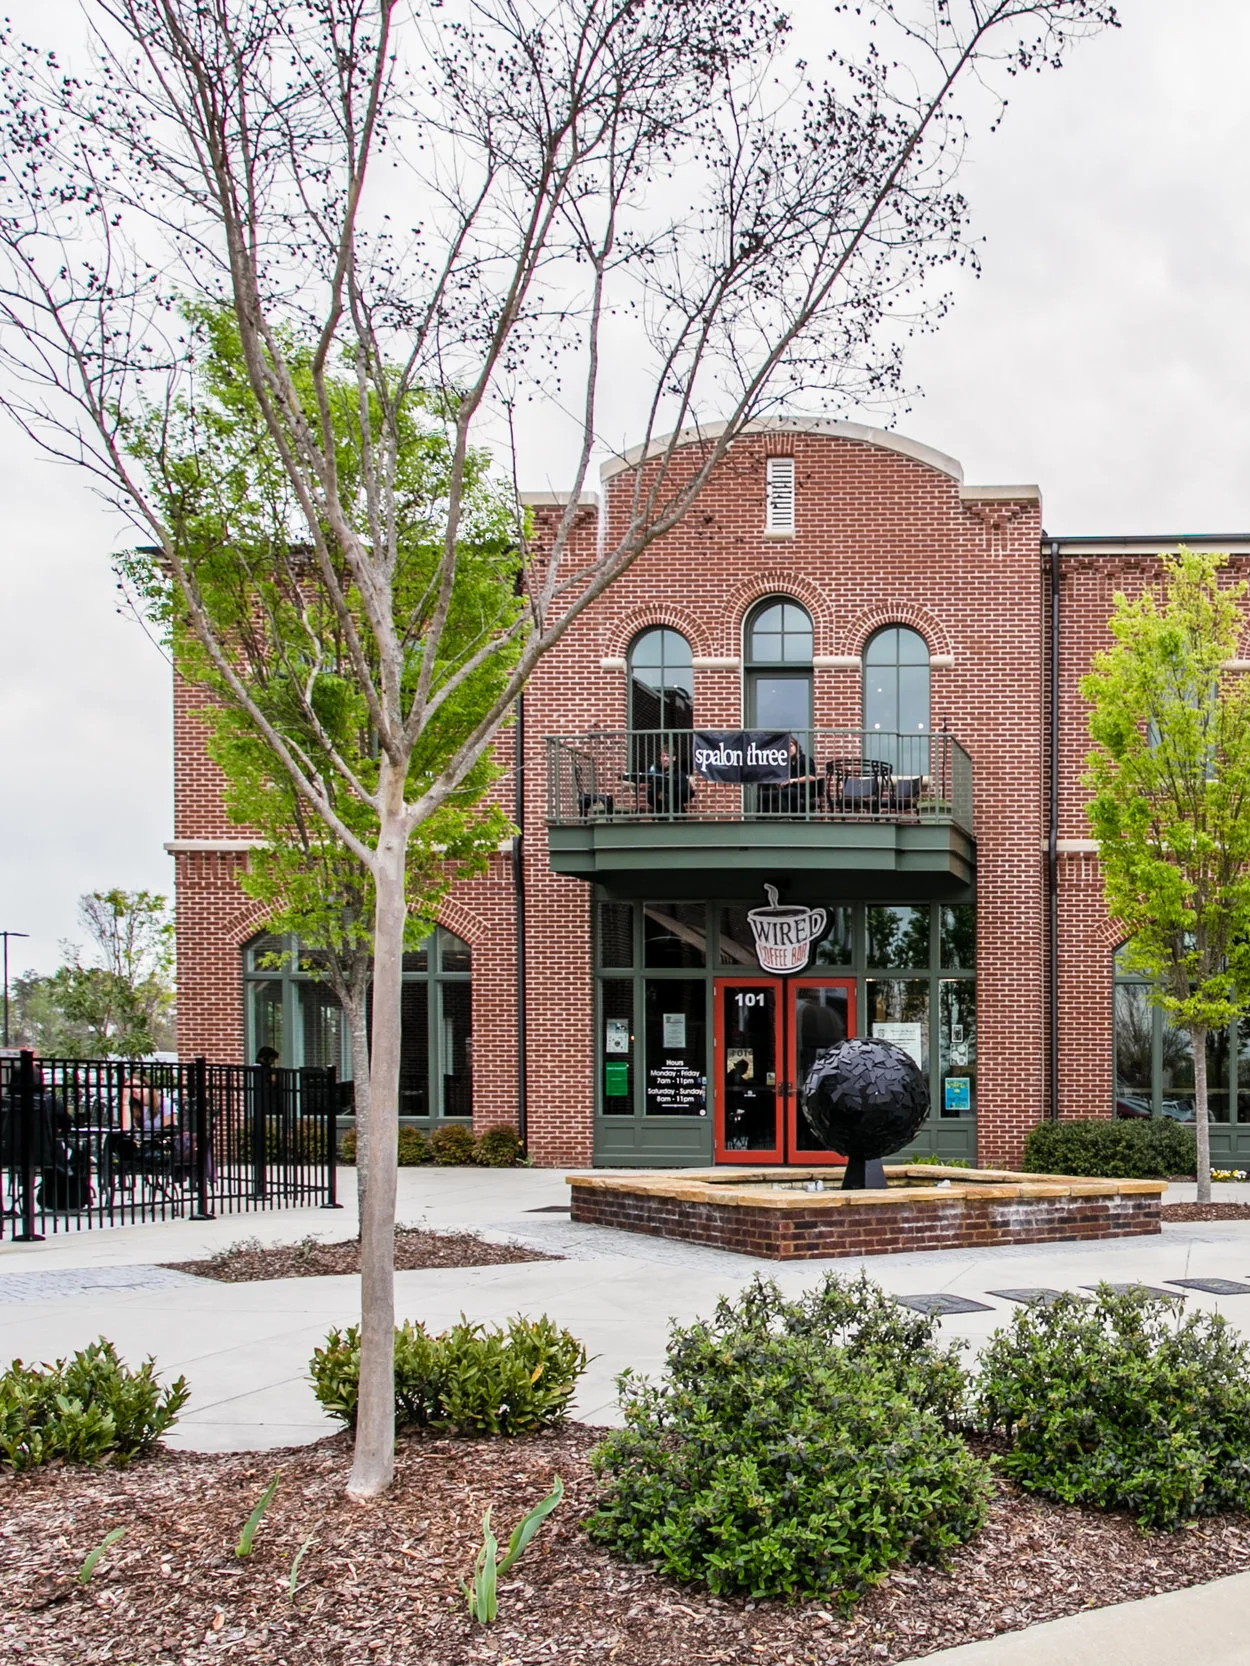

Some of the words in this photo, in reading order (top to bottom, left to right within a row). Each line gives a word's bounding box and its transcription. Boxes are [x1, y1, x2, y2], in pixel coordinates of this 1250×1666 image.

[695, 742, 743, 772] spalon
[747, 742, 788, 766] three
[752, 913, 825, 946] WIRED
[791, 942, 808, 966] BAR
[734, 993, 765, 1007] 101
[676, 1077, 694, 1085] 11pm
